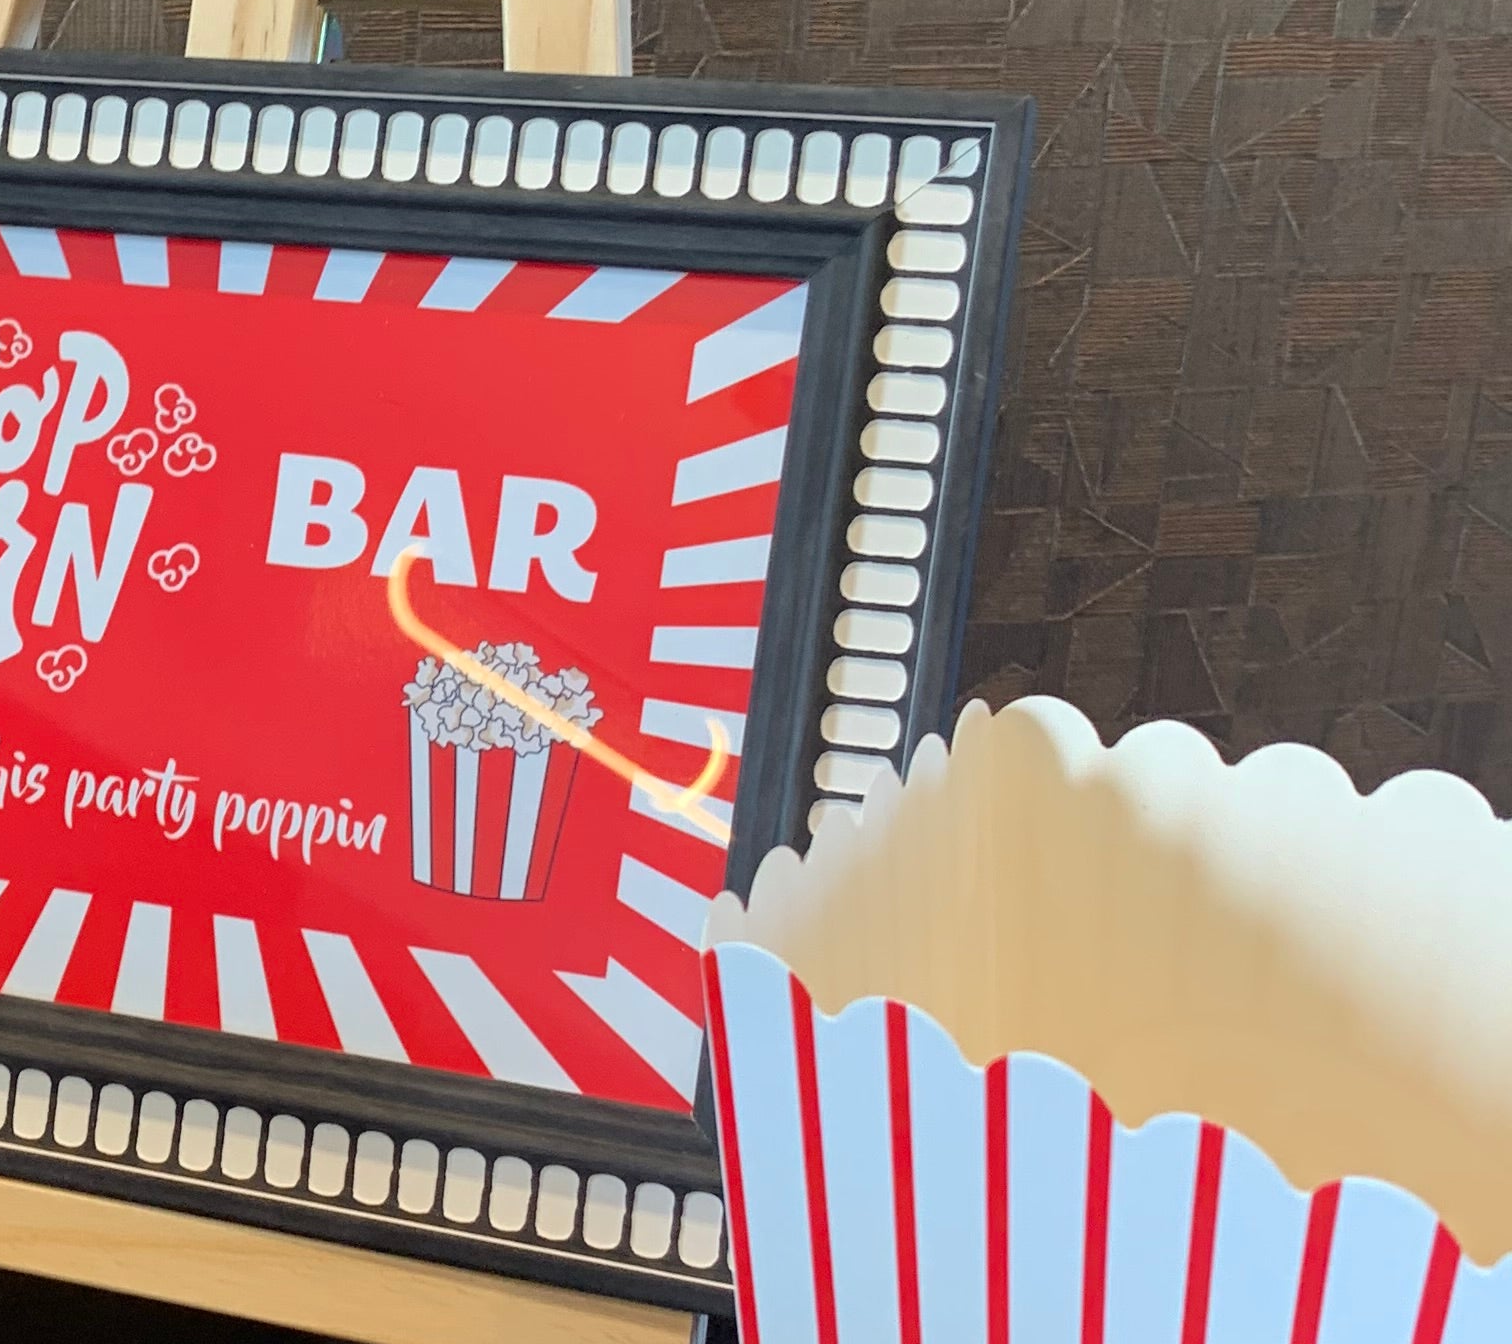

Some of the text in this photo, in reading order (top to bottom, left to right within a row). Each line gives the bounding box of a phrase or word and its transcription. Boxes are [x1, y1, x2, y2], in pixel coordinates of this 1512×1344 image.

[265, 452, 599, 604] BAR
[61, 757, 200, 840] party
[212, 790, 388, 866] poppin
